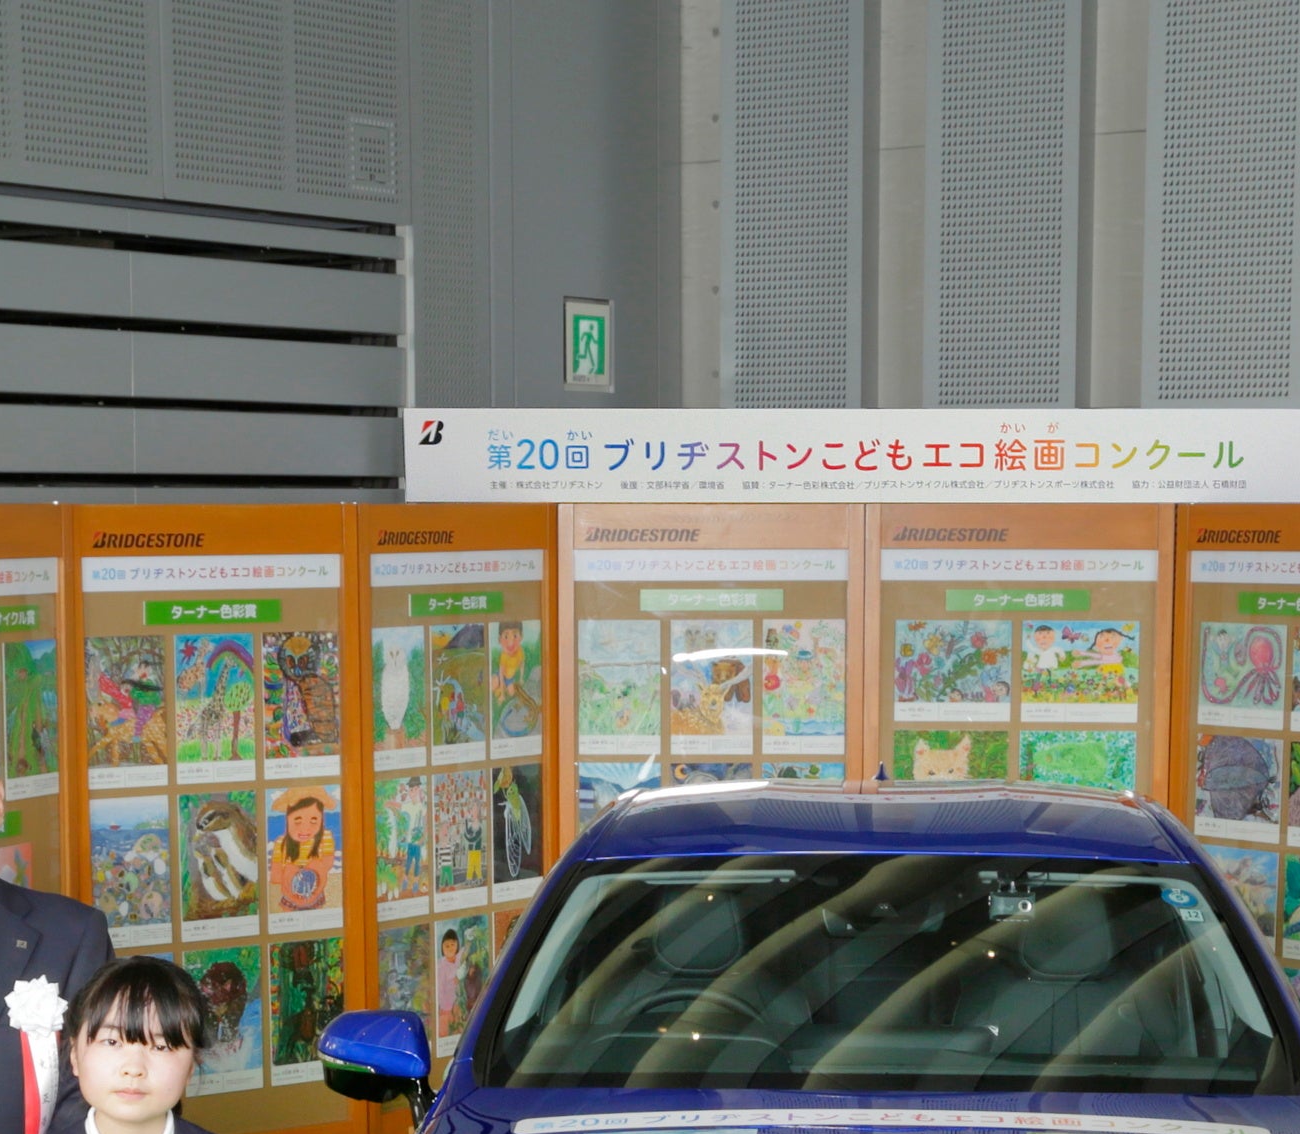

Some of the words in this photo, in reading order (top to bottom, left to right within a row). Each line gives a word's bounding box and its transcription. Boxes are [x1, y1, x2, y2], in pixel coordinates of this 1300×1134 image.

[92, 531, 206, 549] BRIDGESTONE
[377, 530, 455, 546] BRIDGESTONE
[585, 526, 700, 543] BRIDGESTONE
[892, 526, 1009, 543] BRIDGESTONE
[1196, 528, 1282, 544] BRIDGESTONE
